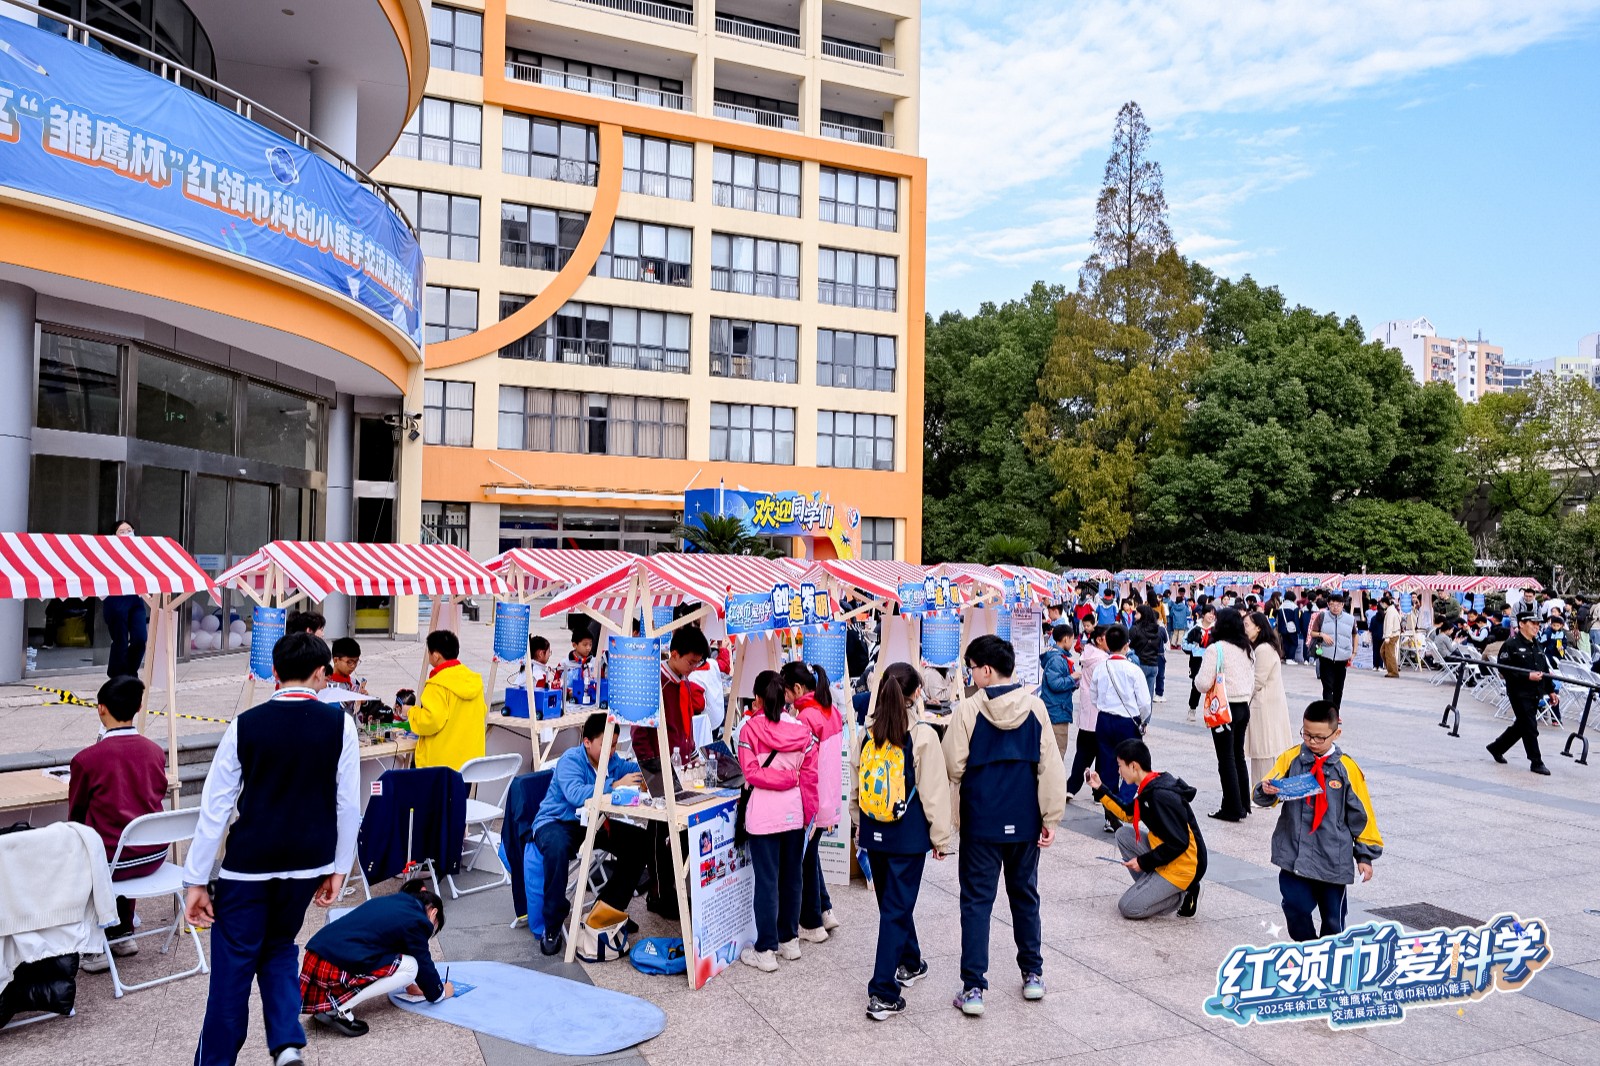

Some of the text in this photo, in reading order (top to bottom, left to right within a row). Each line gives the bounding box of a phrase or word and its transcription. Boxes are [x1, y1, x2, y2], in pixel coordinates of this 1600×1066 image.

[753, 496, 834, 530] 欢迎同学们
[772, 584, 829, 621] 创造发明
